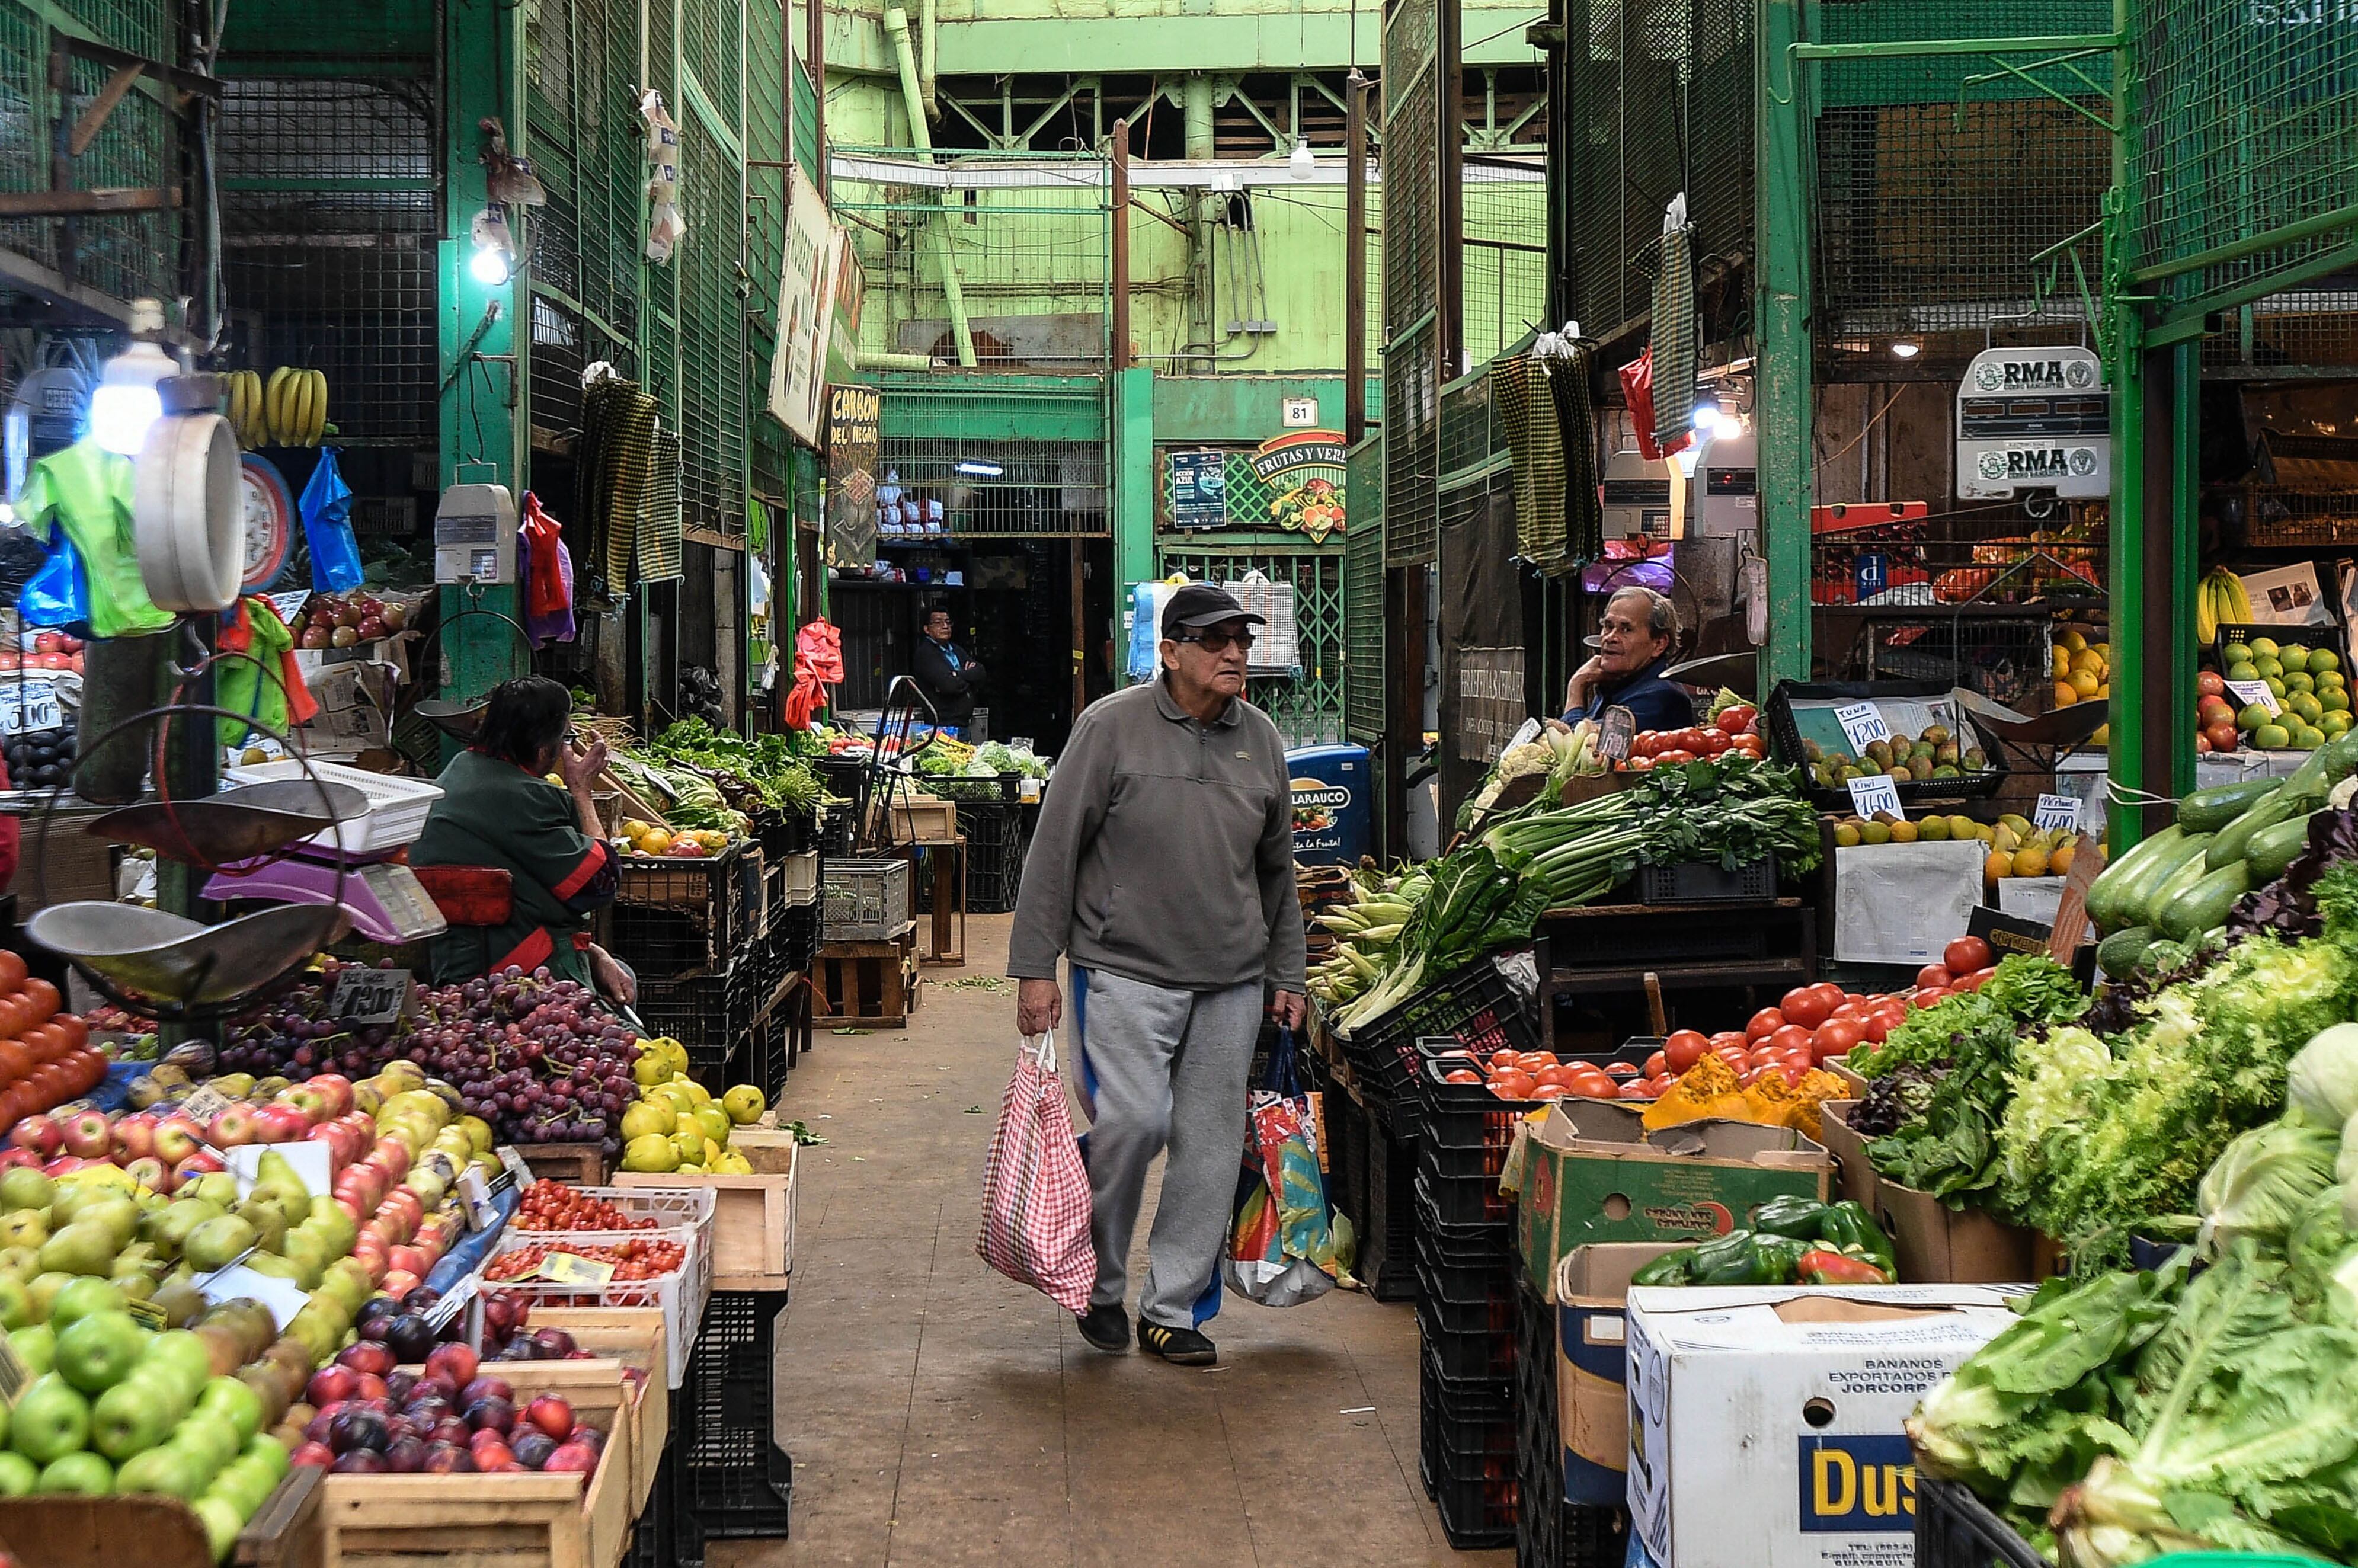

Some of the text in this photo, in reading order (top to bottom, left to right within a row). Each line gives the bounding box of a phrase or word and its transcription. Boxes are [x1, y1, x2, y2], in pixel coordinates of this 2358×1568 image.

[2004, 361, 2065, 383] RMA
[832, 389, 879, 423] CARBON
[1292, 408, 1306, 419] 81
[831, 425, 878, 445] DEL NEGRO
[1256, 448, 1304, 476] FRUTAS
[1306, 447, 1314, 460] Y
[2007, 449, 2068, 472] RMA
[1176, 476, 1194, 485] AZUL
[1853, 779, 1876, 791] Kiwi
[1865, 1359, 1944, 1369] BANANOS
[1829, 1371, 1937, 1382] EXPORTADOS
[1841, 1383, 1928, 1394] JORCORP
